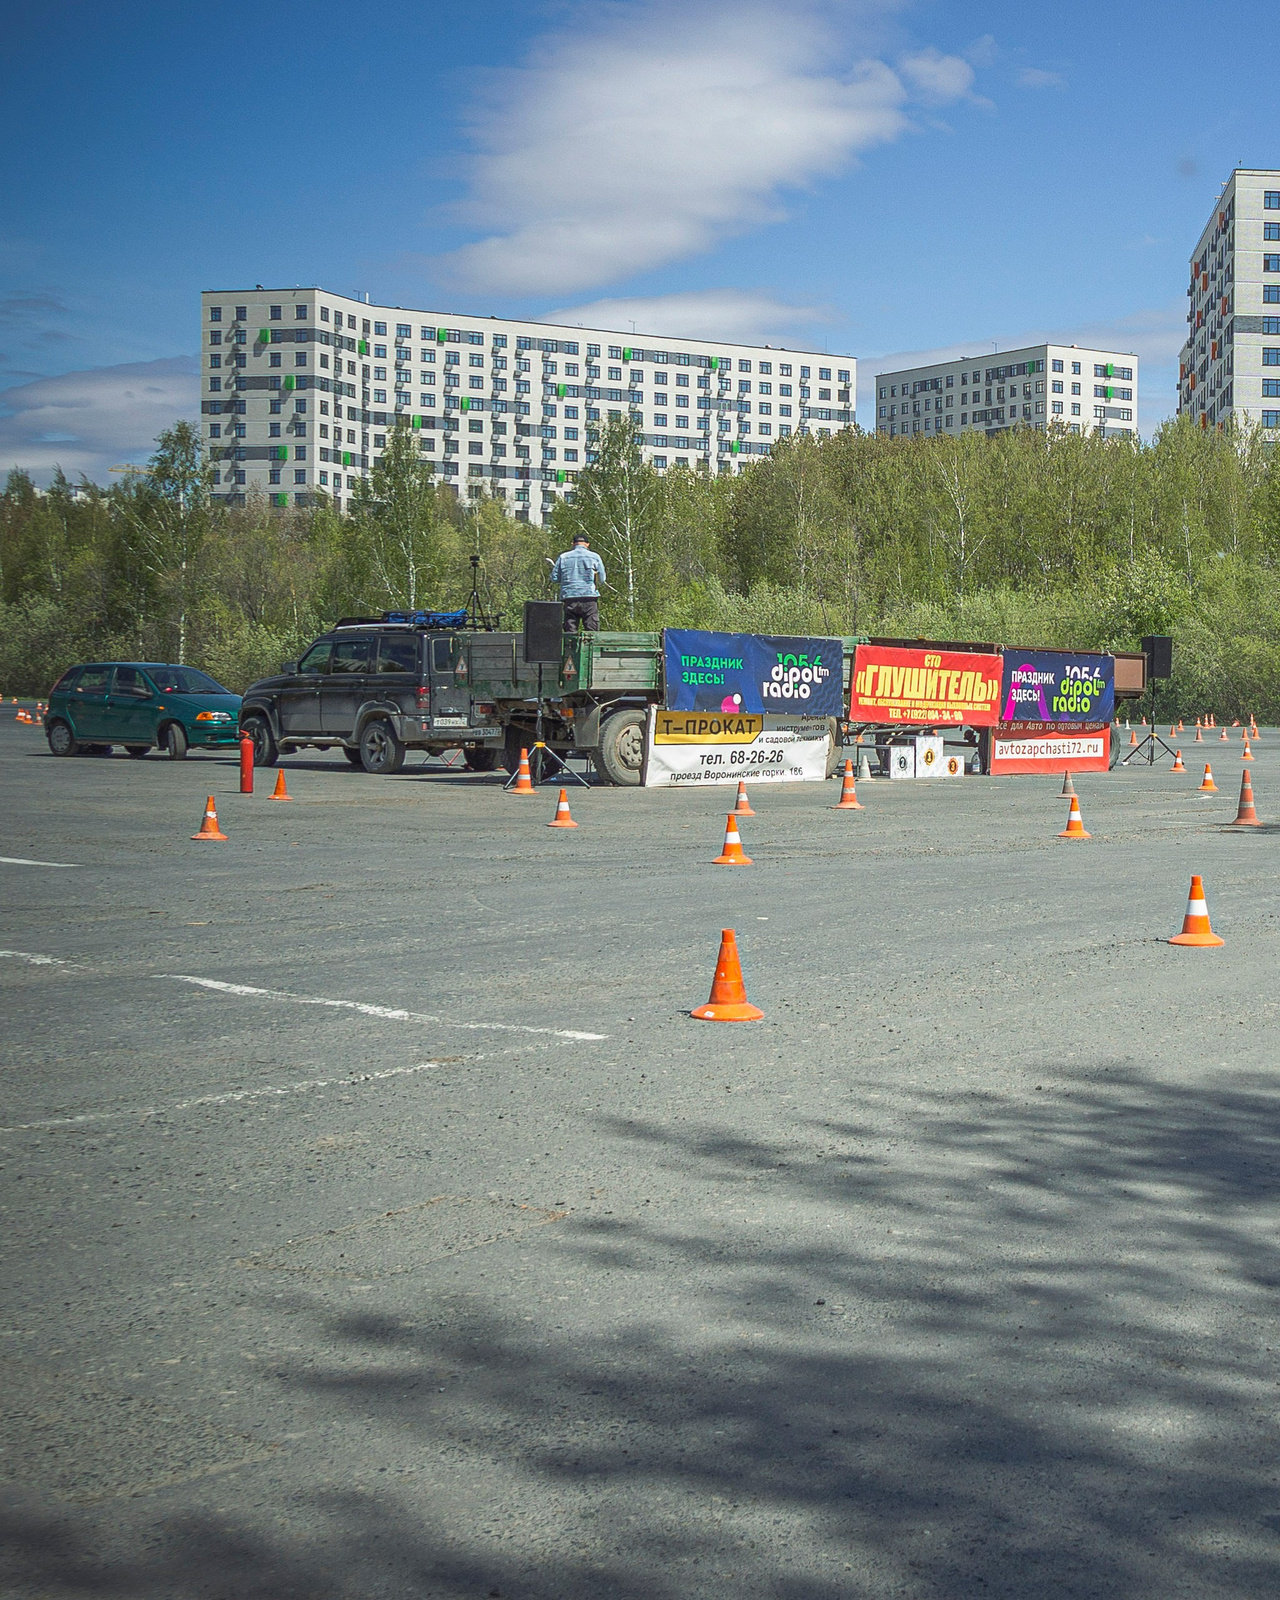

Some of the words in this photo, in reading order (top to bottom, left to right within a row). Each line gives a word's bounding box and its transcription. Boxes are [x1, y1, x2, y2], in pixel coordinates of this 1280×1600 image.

[681, 655, 744, 670] ПРАЗДНИК
[924, 654, 942, 668] СТО
[681, 672, 725, 686] ЗДЕСЬ!
[771, 663, 823, 684] dipol
[1011, 670, 1055, 686] ПРАЗДНИК
[762, 681, 811, 699] radio
[855, 664, 999, 702] «ГЛУШИТЕЛЬ»
[1060, 677, 1099, 697] dipol
[1011, 688, 1041, 703] ЗДЕСЬ!
[1052, 696, 1091, 713] radio
[663, 719, 756, 736] Т-ПРОКАТ
[1010, 722, 1024, 731] для
[1026, 721, 1043, 730] Авто
[1046, 722, 1056, 730] по
[765, 734, 796, 745] садовой
[699, 753, 725, 766] тел.
[730, 749, 784, 764] 68-26-26
[998, 742, 1099, 758] avtozapchasti72.ru
[670, 770, 702, 781] проезд
[704, 769, 761, 780] Воронинские
[790, 767, 804, 776] 186
